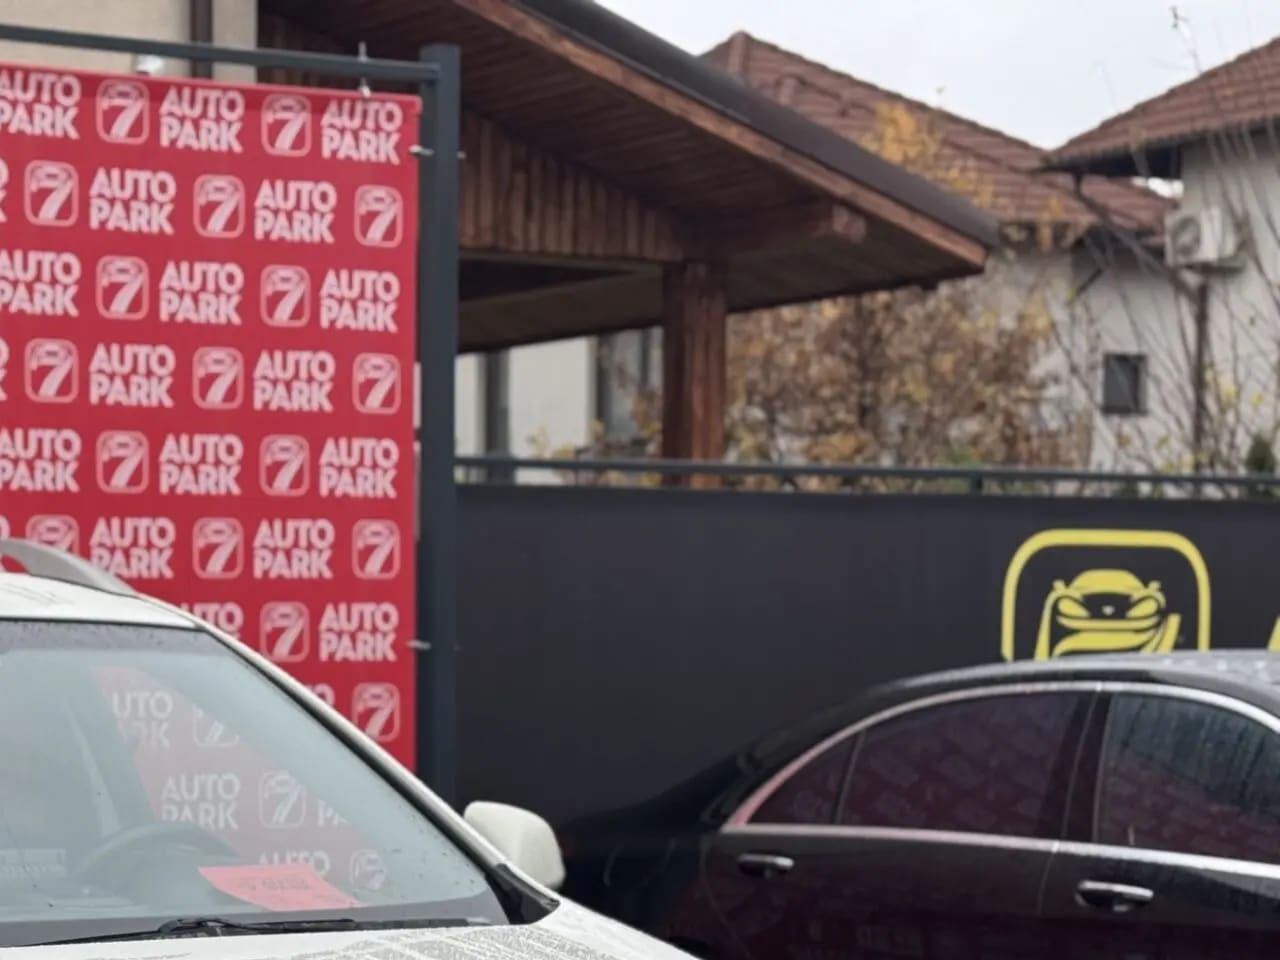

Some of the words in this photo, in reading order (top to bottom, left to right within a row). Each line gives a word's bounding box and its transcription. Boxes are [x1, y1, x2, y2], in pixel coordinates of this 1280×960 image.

[160, 85, 244, 122] AUTO
[320, 99, 403, 131] AUTO
[160, 117, 243, 153] PARK
[321, 129, 401, 164] PARK
[89, 168, 176, 203] AUTO
[254, 180, 337, 214] AUTO
[89, 200, 175, 235] PARK
[254, 210, 334, 244] PARK
[159, 261, 245, 295] AUTO
[320, 269, 400, 302] AUTO
[159, 292, 242, 326] PARK
[320, 299, 398, 333] PARK
[89, 342, 176, 377] AUTO
[253, 350, 335, 382] AUTO
[89, 373, 174, 408] PARK
[253, 380, 334, 413] PARK
[160, 433, 244, 465] AUTO
[319, 437, 400, 468] AUTO
[160, 464, 242, 495] PARK
[320, 467, 397, 498] PARK
[90, 517, 176, 549] AUTO
[254, 519, 334, 549] AUTO
[254, 548, 333, 579] PARK
[320, 603, 399, 632] AUTO
[320, 632, 397, 661] PARK
